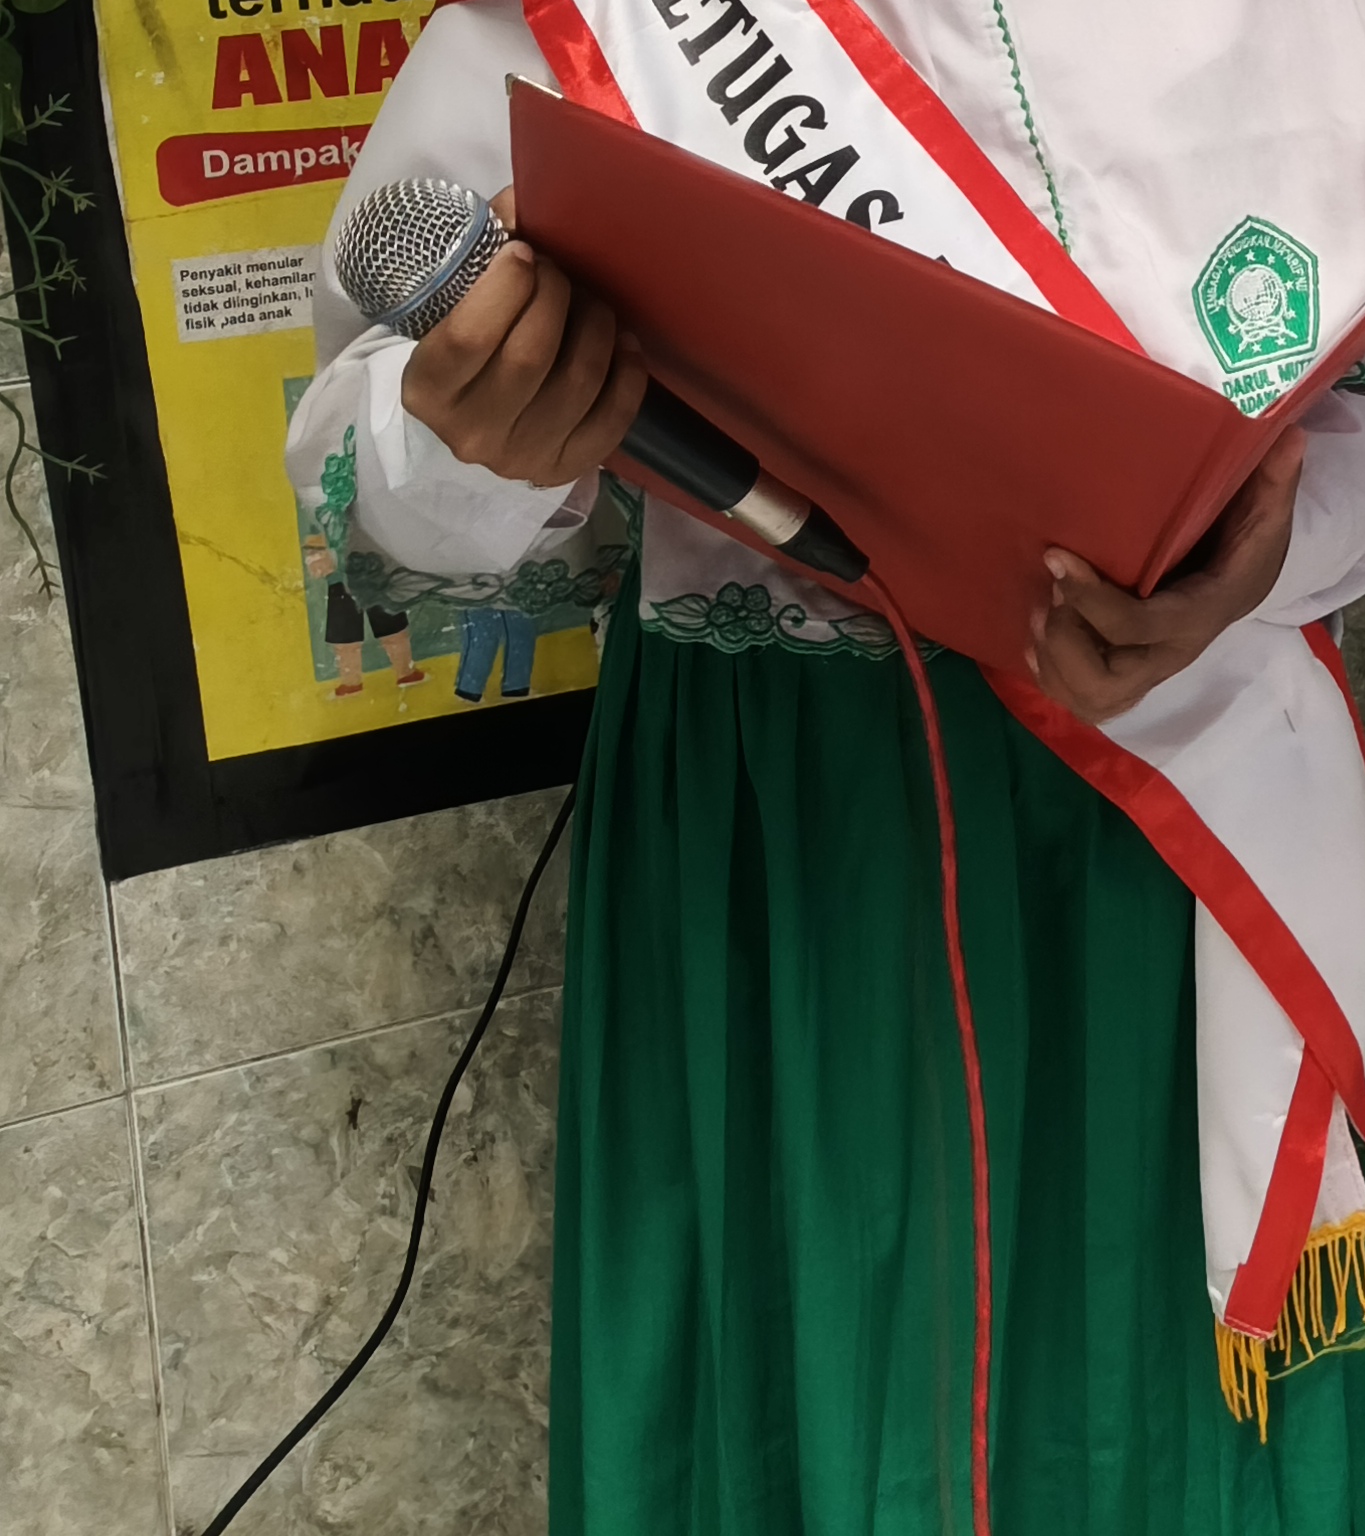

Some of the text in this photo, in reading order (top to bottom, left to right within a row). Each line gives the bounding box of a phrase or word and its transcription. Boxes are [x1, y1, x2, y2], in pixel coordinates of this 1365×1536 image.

[211, 15, 430, 110] ANA
[202, 136, 363, 180] Dampak
[179, 256, 304, 283] Penyakit menular
[181, 281, 242, 299] seksual,
[183, 298, 219, 315] tidak
[223, 290, 302, 310] diinginkan,
[185, 316, 216, 331] fisik
[258, 306, 293, 322] anak
[1222, 369, 1275, 400] DARUL
